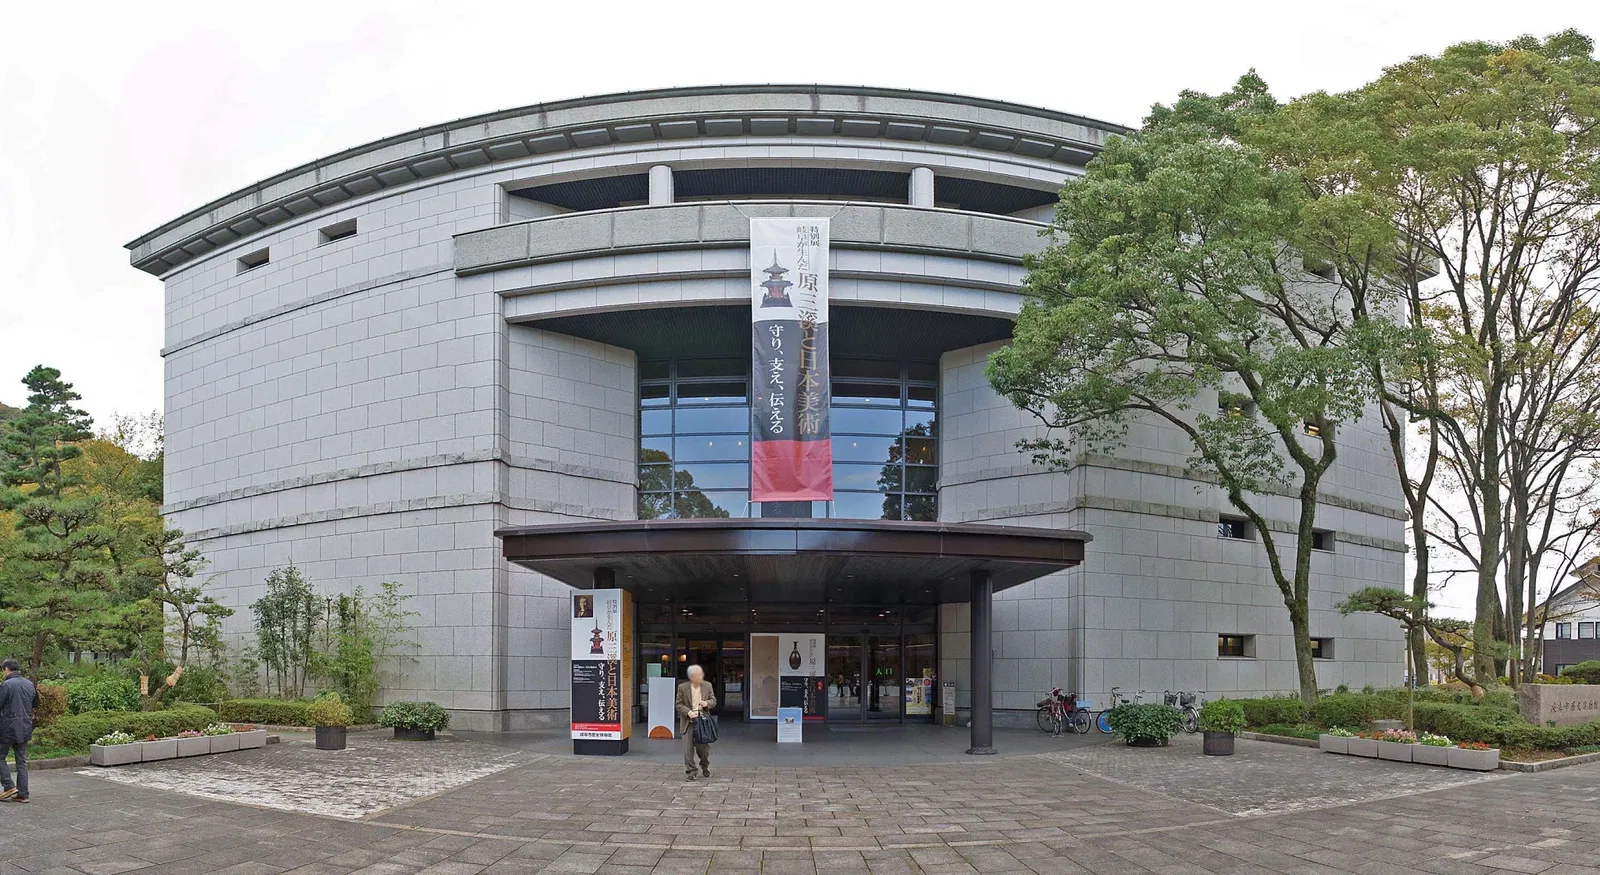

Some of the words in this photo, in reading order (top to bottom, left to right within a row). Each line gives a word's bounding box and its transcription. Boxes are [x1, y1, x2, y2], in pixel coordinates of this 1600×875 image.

[809, 226, 820, 247] 特別展
[768, 324, 785, 435] 守り、支え、伝える
[875, 667, 893, 676] 入口
